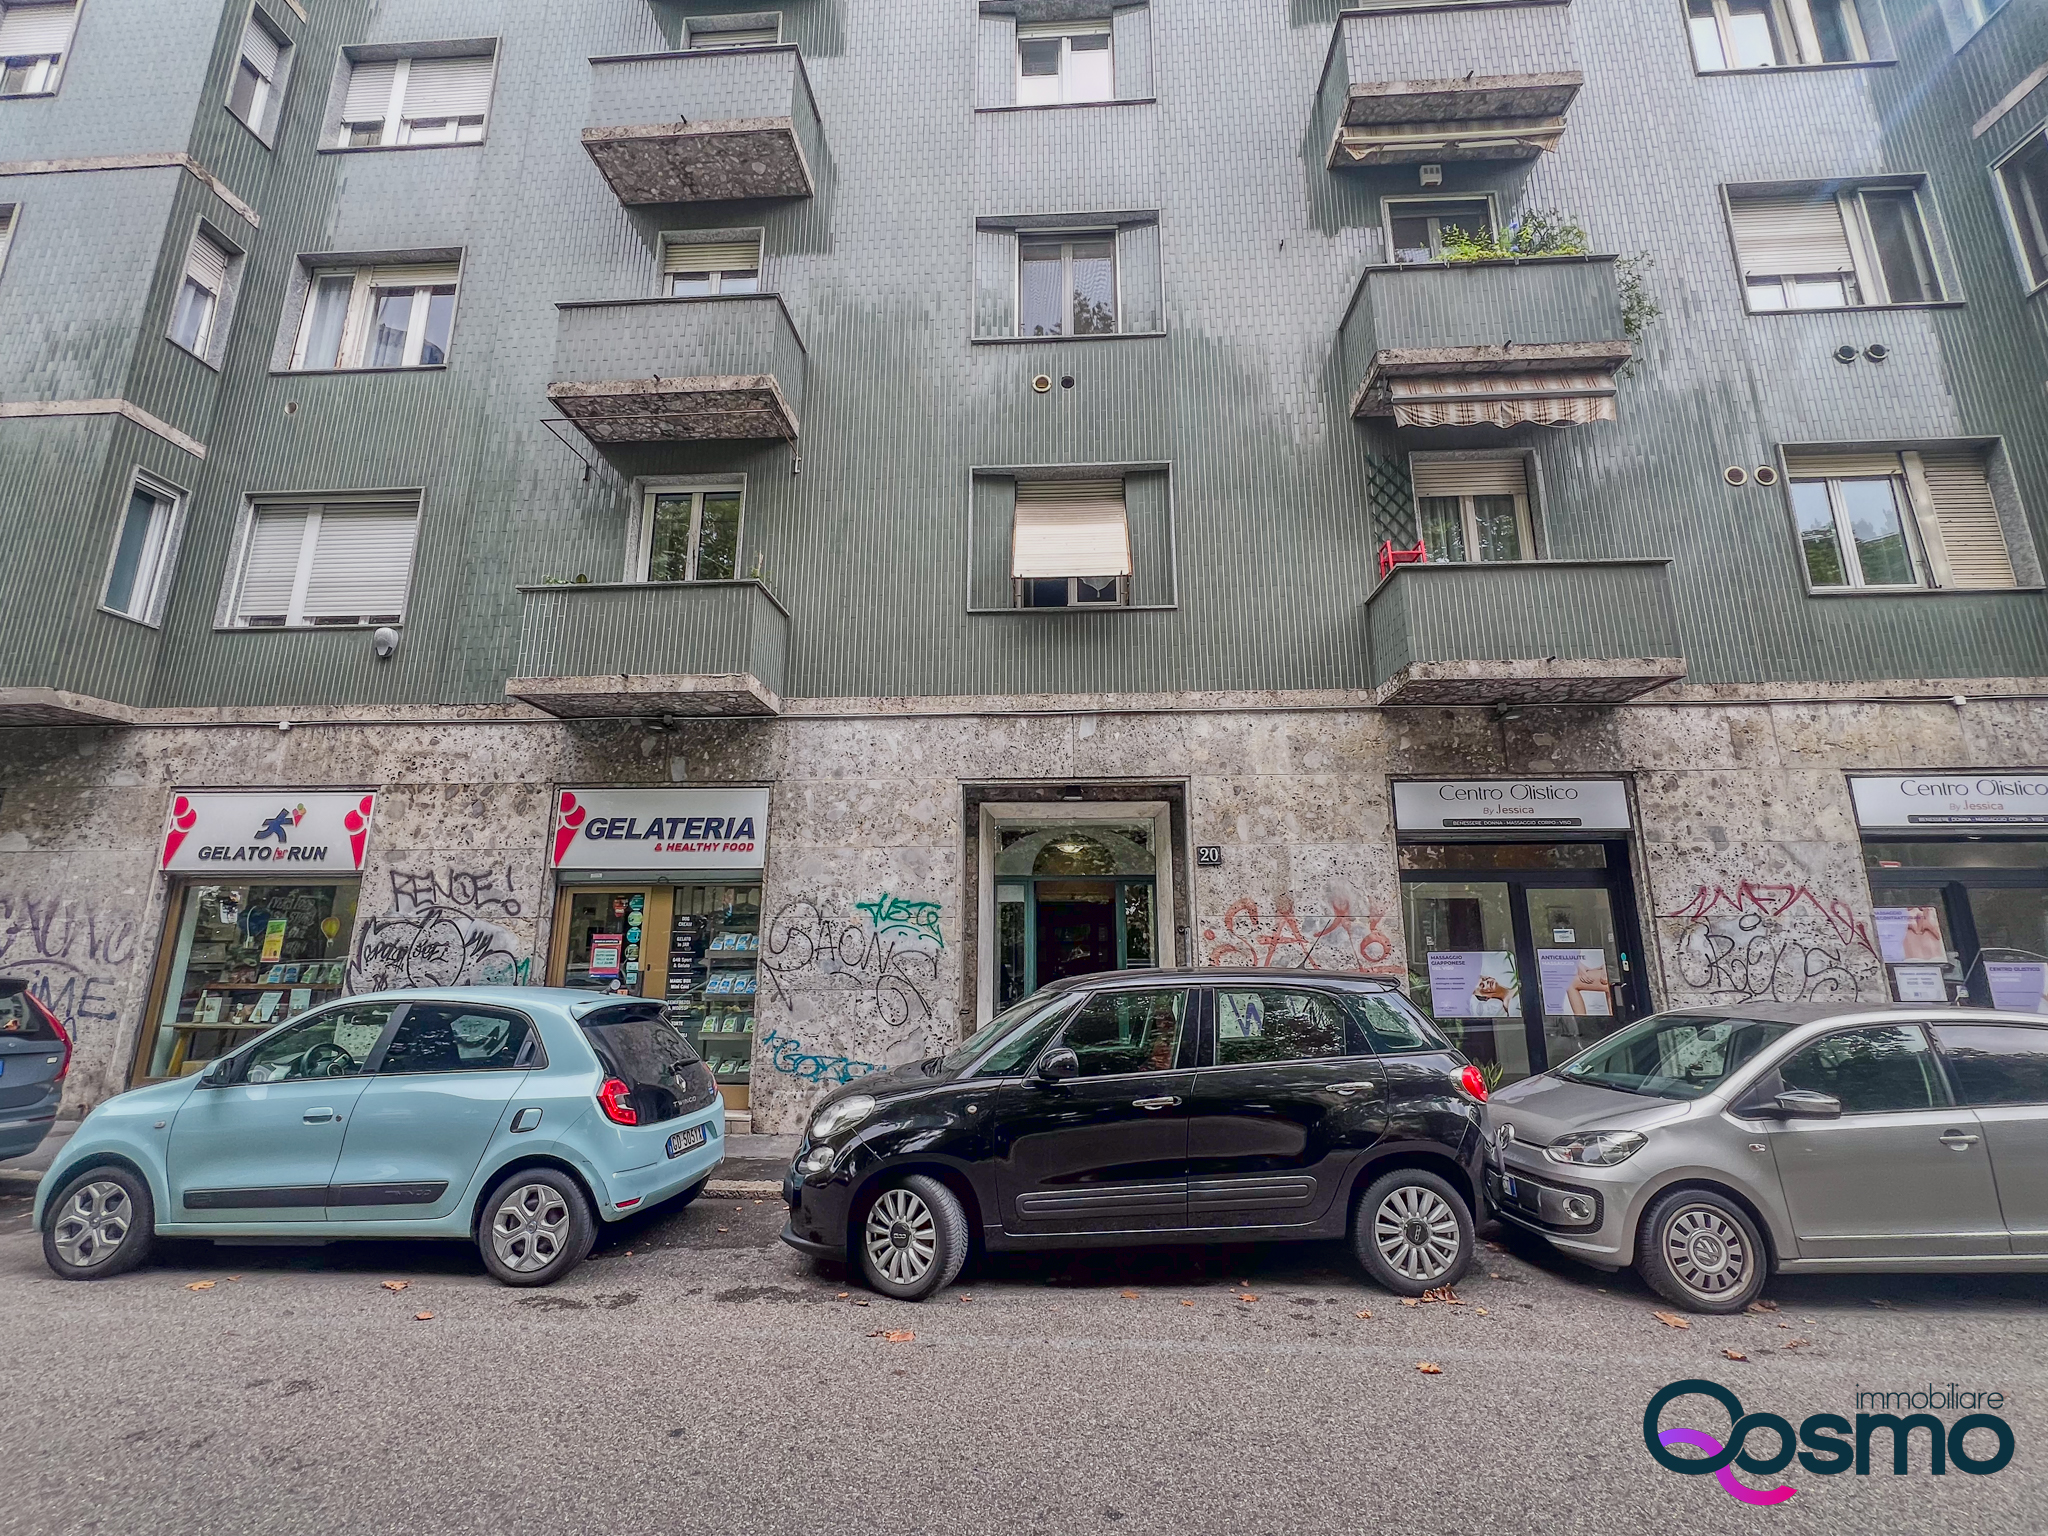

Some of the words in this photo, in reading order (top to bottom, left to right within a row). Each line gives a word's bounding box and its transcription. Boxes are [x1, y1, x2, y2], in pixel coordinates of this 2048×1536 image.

[1439, 784, 1503, 801] Centro
[1510, 783, 1578, 801] Olistico
[1900, 779, 1969, 796] Centro
[1976, 779, 2048, 796] Olistico
[1483, 807, 1494, 815] By
[1496, 804, 1535, 815] Jessica
[1949, 803, 1961, 812] By
[1963, 800, 2004, 811] Jessica
[584, 817, 756, 841] GELATERIA
[198, 846, 272, 861] GELATO
[287, 846, 328, 861] RUN
[655, 843, 663, 852] &
[666, 843, 721, 852] HEALTHY
[722, 843, 755, 852] FOOD
[1200, 847, 1219, 862] 20
